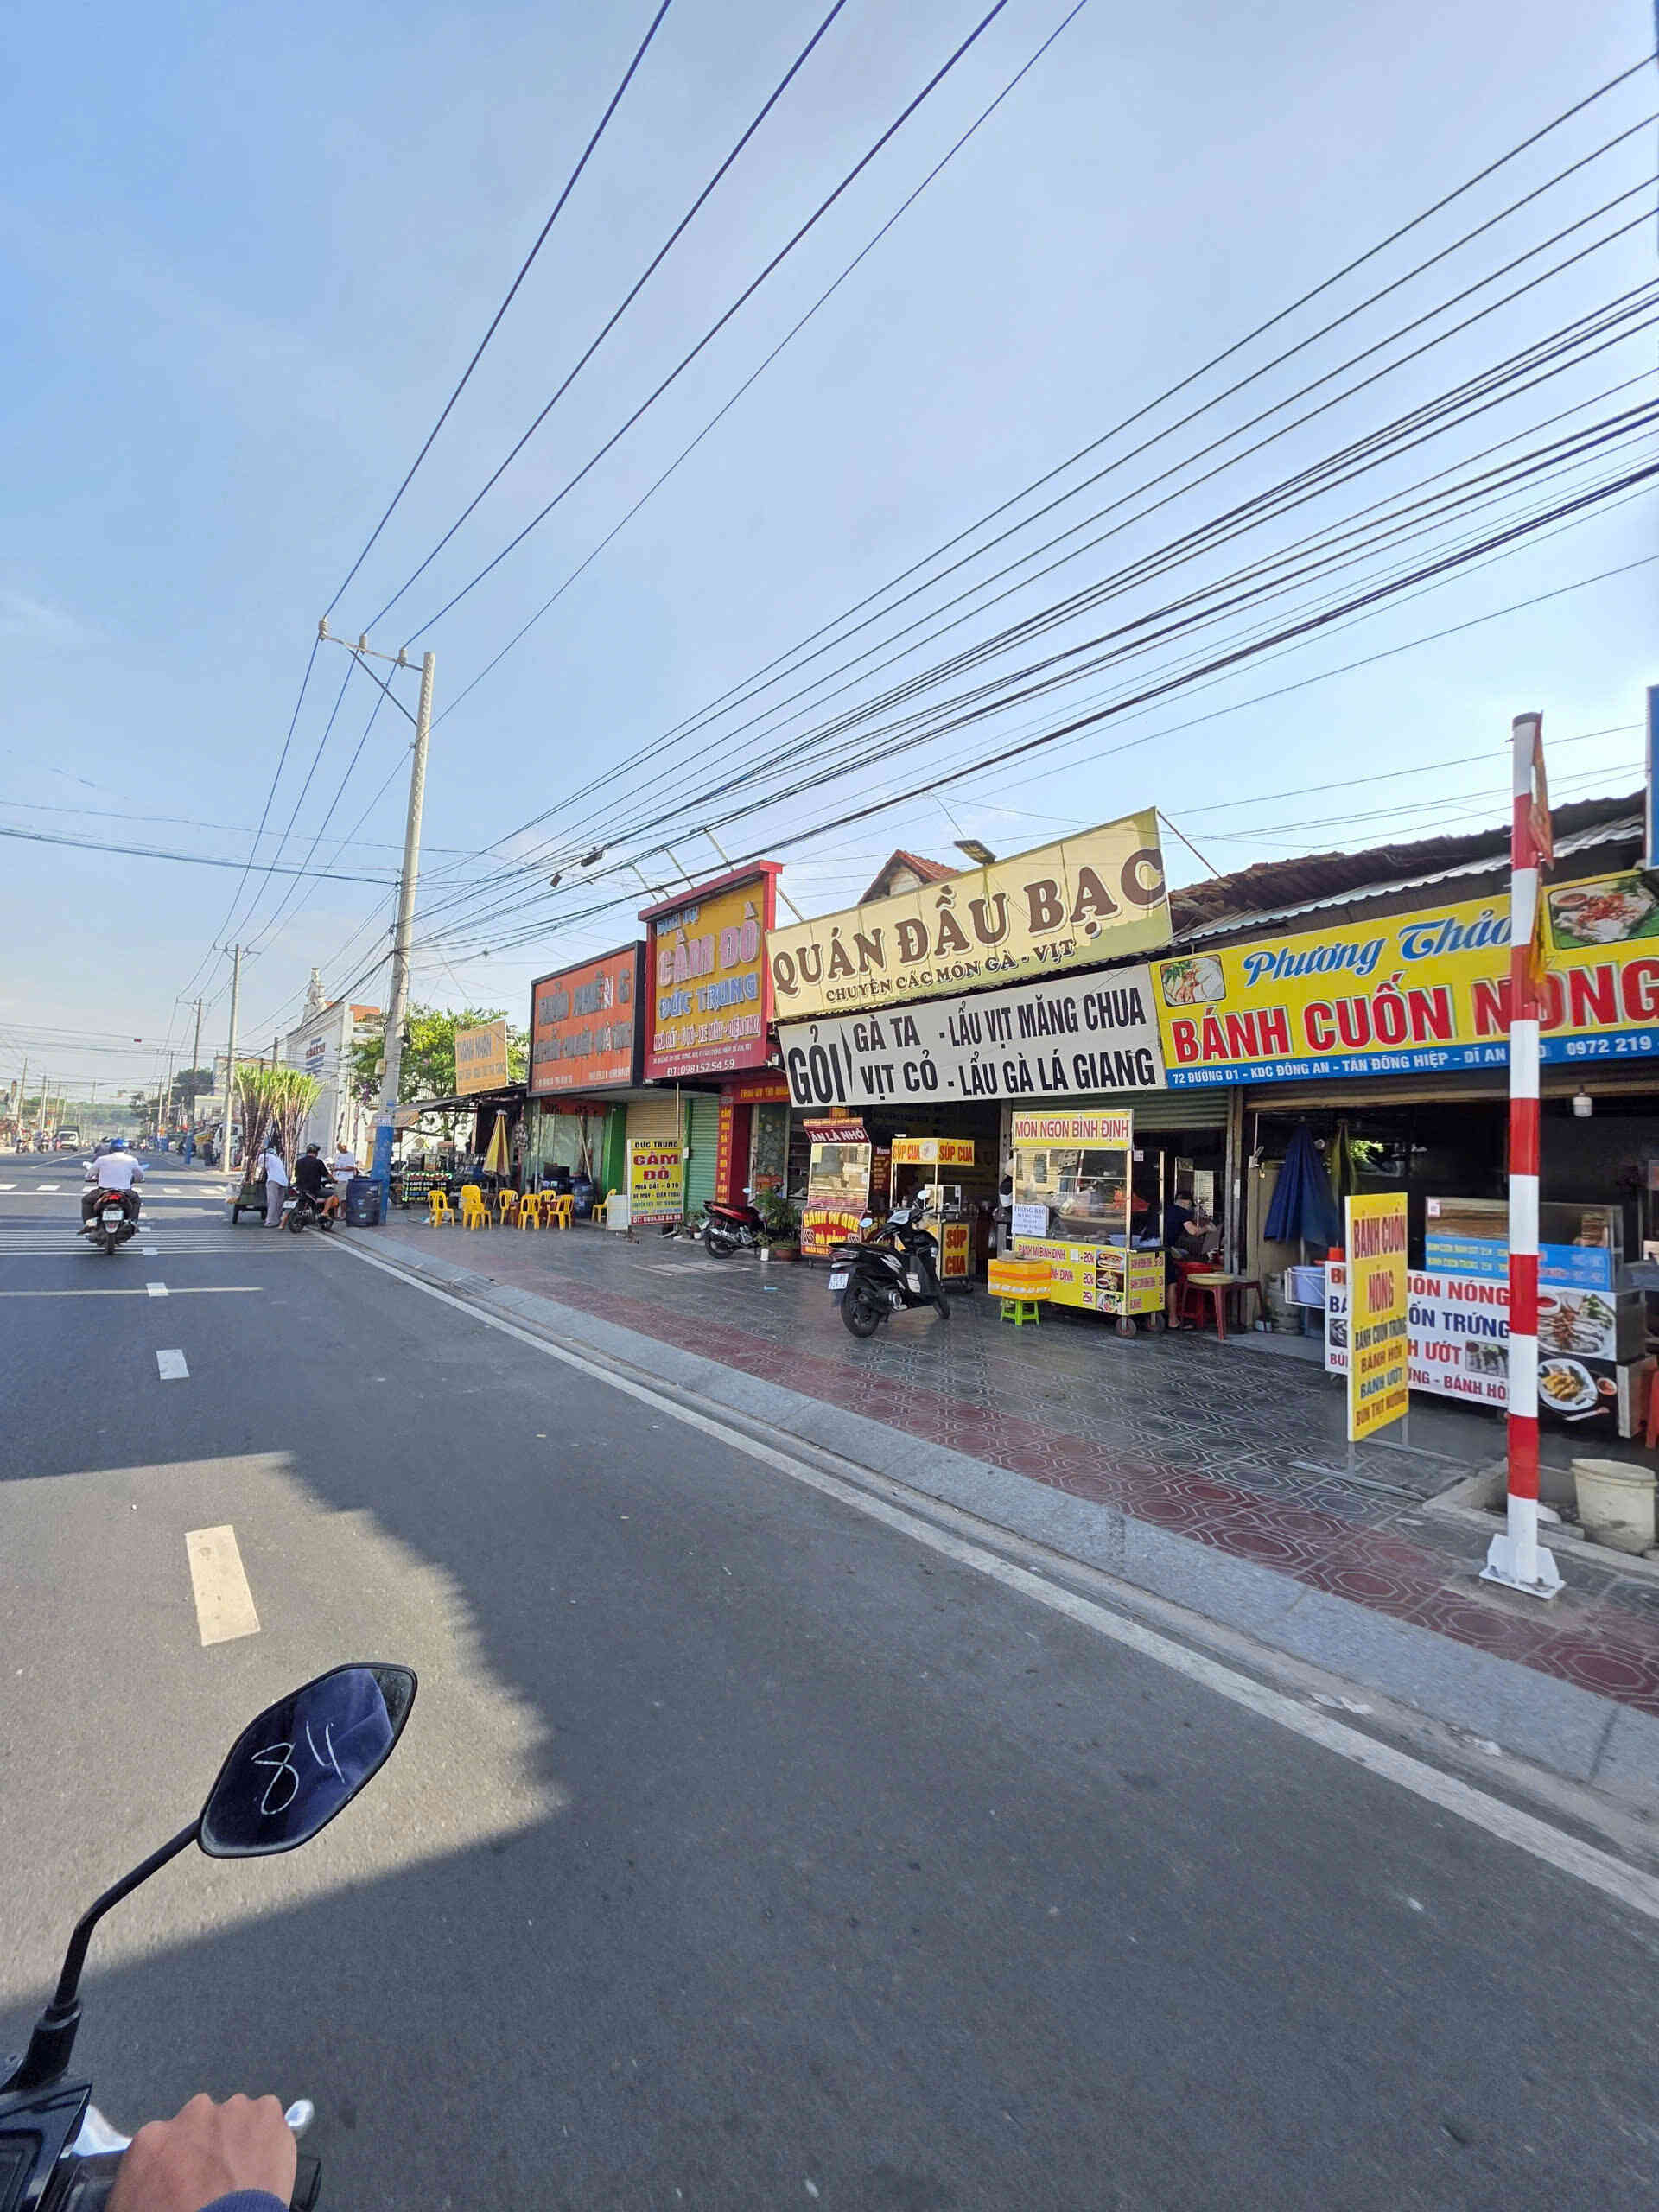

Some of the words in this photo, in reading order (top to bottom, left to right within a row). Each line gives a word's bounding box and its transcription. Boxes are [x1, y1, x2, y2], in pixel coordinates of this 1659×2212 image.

[773, 927, 885, 995] QUÁN
[895, 885, 1007, 965] ĐẦU
[1024, 849, 1166, 936] BẠC
[826, 977, 892, 1002] CHUYÊN
[895, 968, 934, 990] CÁC
[936, 960, 980, 983] MÓN
[985, 950, 1017, 972] GÀ
[1033, 938, 1077, 964] VỊT
[1243, 938, 1387, 987] Phương
[1398, 909, 1510, 961] Thảo
[853, 1014, 887, 1052] GÀ
[889, 1015, 921, 1048] TA
[949, 1001, 982, 1047] LẨU
[985, 1007, 1013, 1049] VỊT
[1017, 995, 1079, 1039] MĂNG
[1083, 988, 1147, 1031] CHUA
[1171, 1005, 1290, 1063] BÁNH
[1303, 971, 1454, 1052] CUỐN
[787, 1024, 847, 1105] GỎI
[860, 1064, 895, 1101] VỊT
[903, 1049, 938, 1092] CỎ
[958, 1051, 999, 1096] LẨU
[1002, 1052, 1035, 1094] GÀ
[1037, 1049, 1070, 1090] LÁ
[1072, 1048, 1157, 1090] GIANG
[1173, 1074, 1186, 1084] 72
[1252, 1067, 1274, 1078] KDC
[1313, 1062, 1330, 1073] AN
[1341, 1057, 1368, 1071] TÂN
[1413, 1050, 1449, 1069] HIỆP
[1484, 1047, 1506, 1062] AN
[1567, 1039, 1610, 1056] 0972
[1615, 1036, 1653, 1052] 219
[939, 1142, 955, 1161] SÚP
[957, 1147, 973, 1161] CUA
[1015, 1116, 1038, 1138] MÓN
[1040, 1120, 1070, 1138] NGON
[1071, 1116, 1098, 1138] BÌNH
[1101, 1119, 1129, 1141] ĐỊNH
[945, 1225, 967, 1249] SÚP
[1354, 1210, 1380, 1258] BÁNH
[1369, 1265, 1394, 1314] NÓNG
[1448, 1280, 1510, 1306] NÓNG
[1442, 1312, 1510, 1339] TRỨNG
[1425, 1340, 1462, 1365] ƯỚT
[1444, 1374, 1483, 1395] BÁNH
